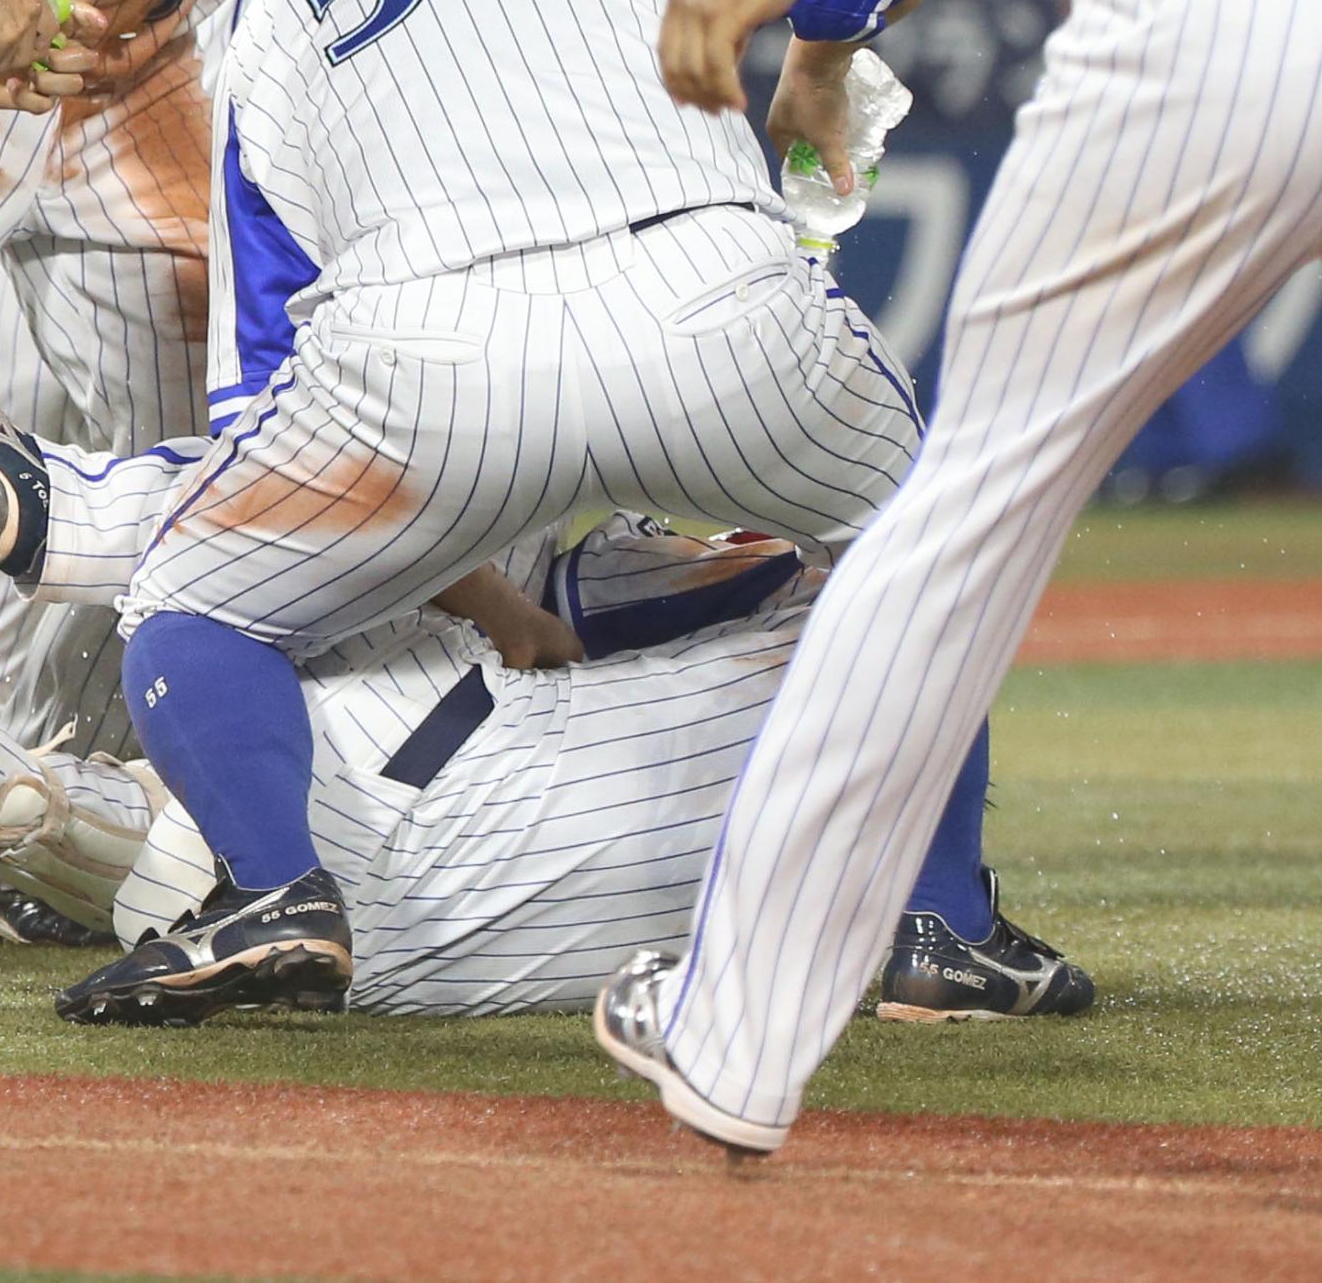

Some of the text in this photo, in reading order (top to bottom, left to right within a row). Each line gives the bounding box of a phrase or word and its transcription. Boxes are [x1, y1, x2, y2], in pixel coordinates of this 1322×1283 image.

[284, 901, 339, 915] GOMEZ
[919, 962, 987, 990] 55 GOMEZ
